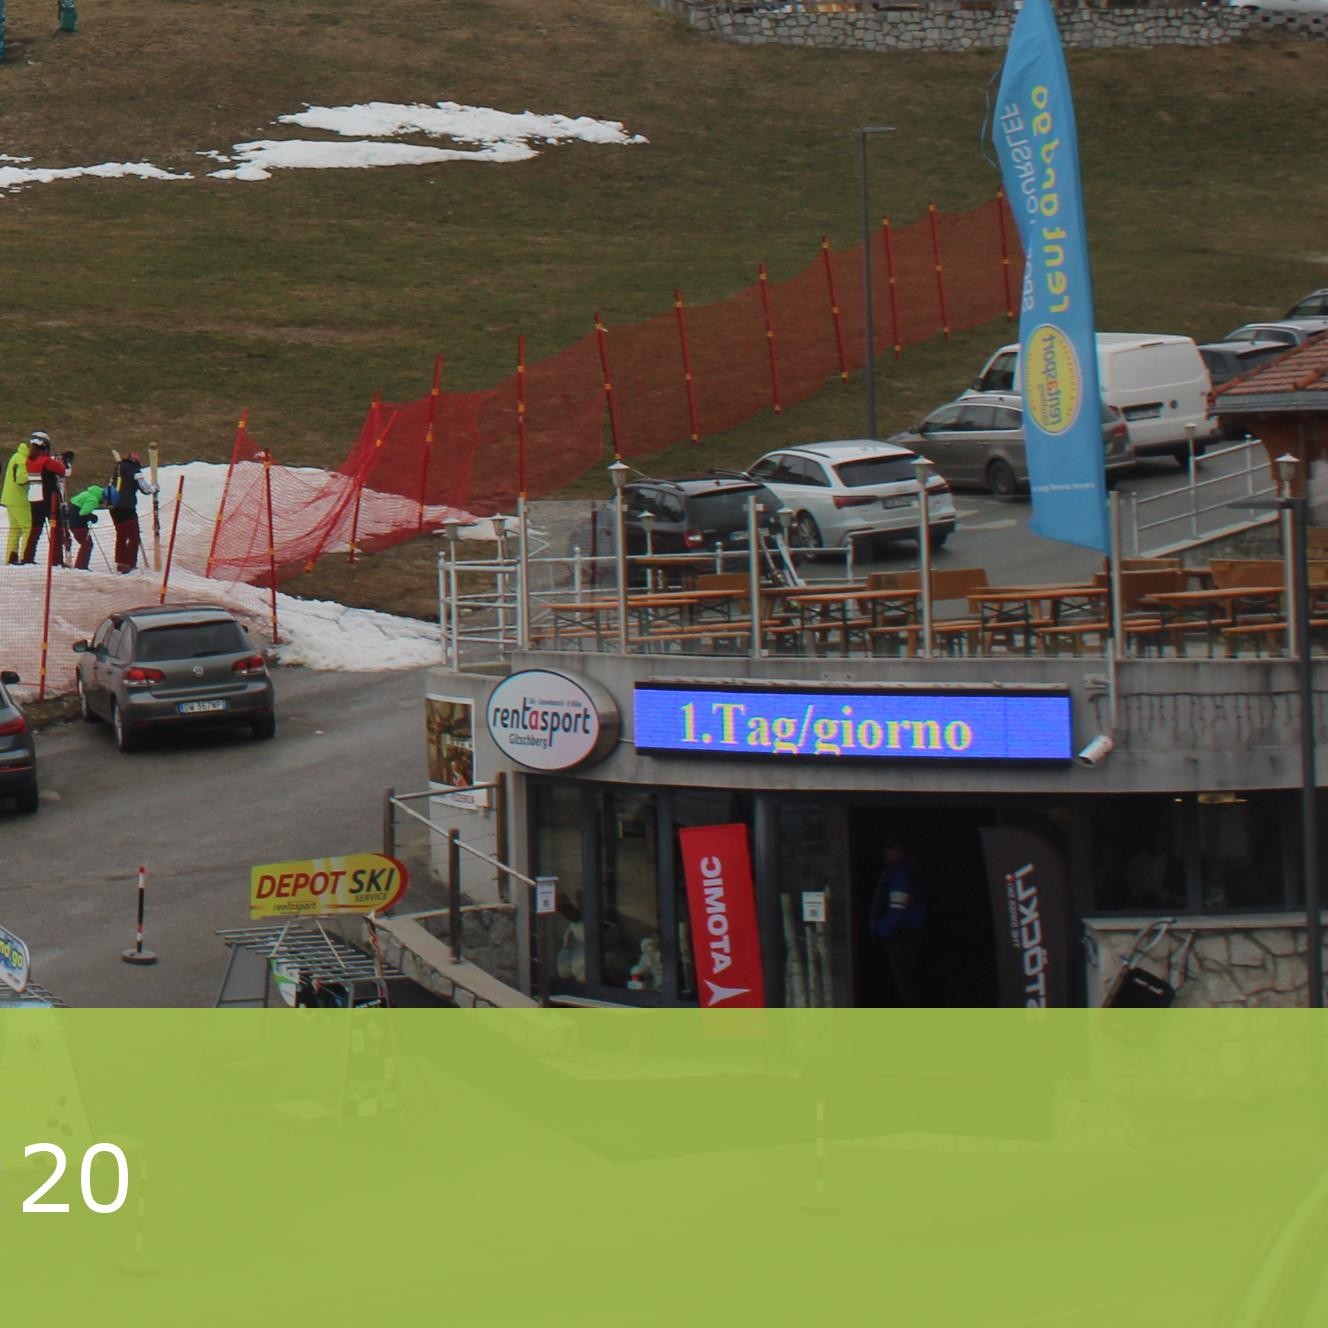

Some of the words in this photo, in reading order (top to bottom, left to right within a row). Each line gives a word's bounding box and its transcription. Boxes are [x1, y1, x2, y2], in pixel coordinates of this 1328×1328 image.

[493, 697, 591, 747] rentasport
[679, 701, 973, 756] 1.Tag/giorno
[509, 733, 548, 749] Gitschberg
[255, 870, 347, 899] DEPOT
[348, 867, 396, 894] SKI
[354, 892, 388, 903] SERVICE
[11, 950, 24, 968] go
